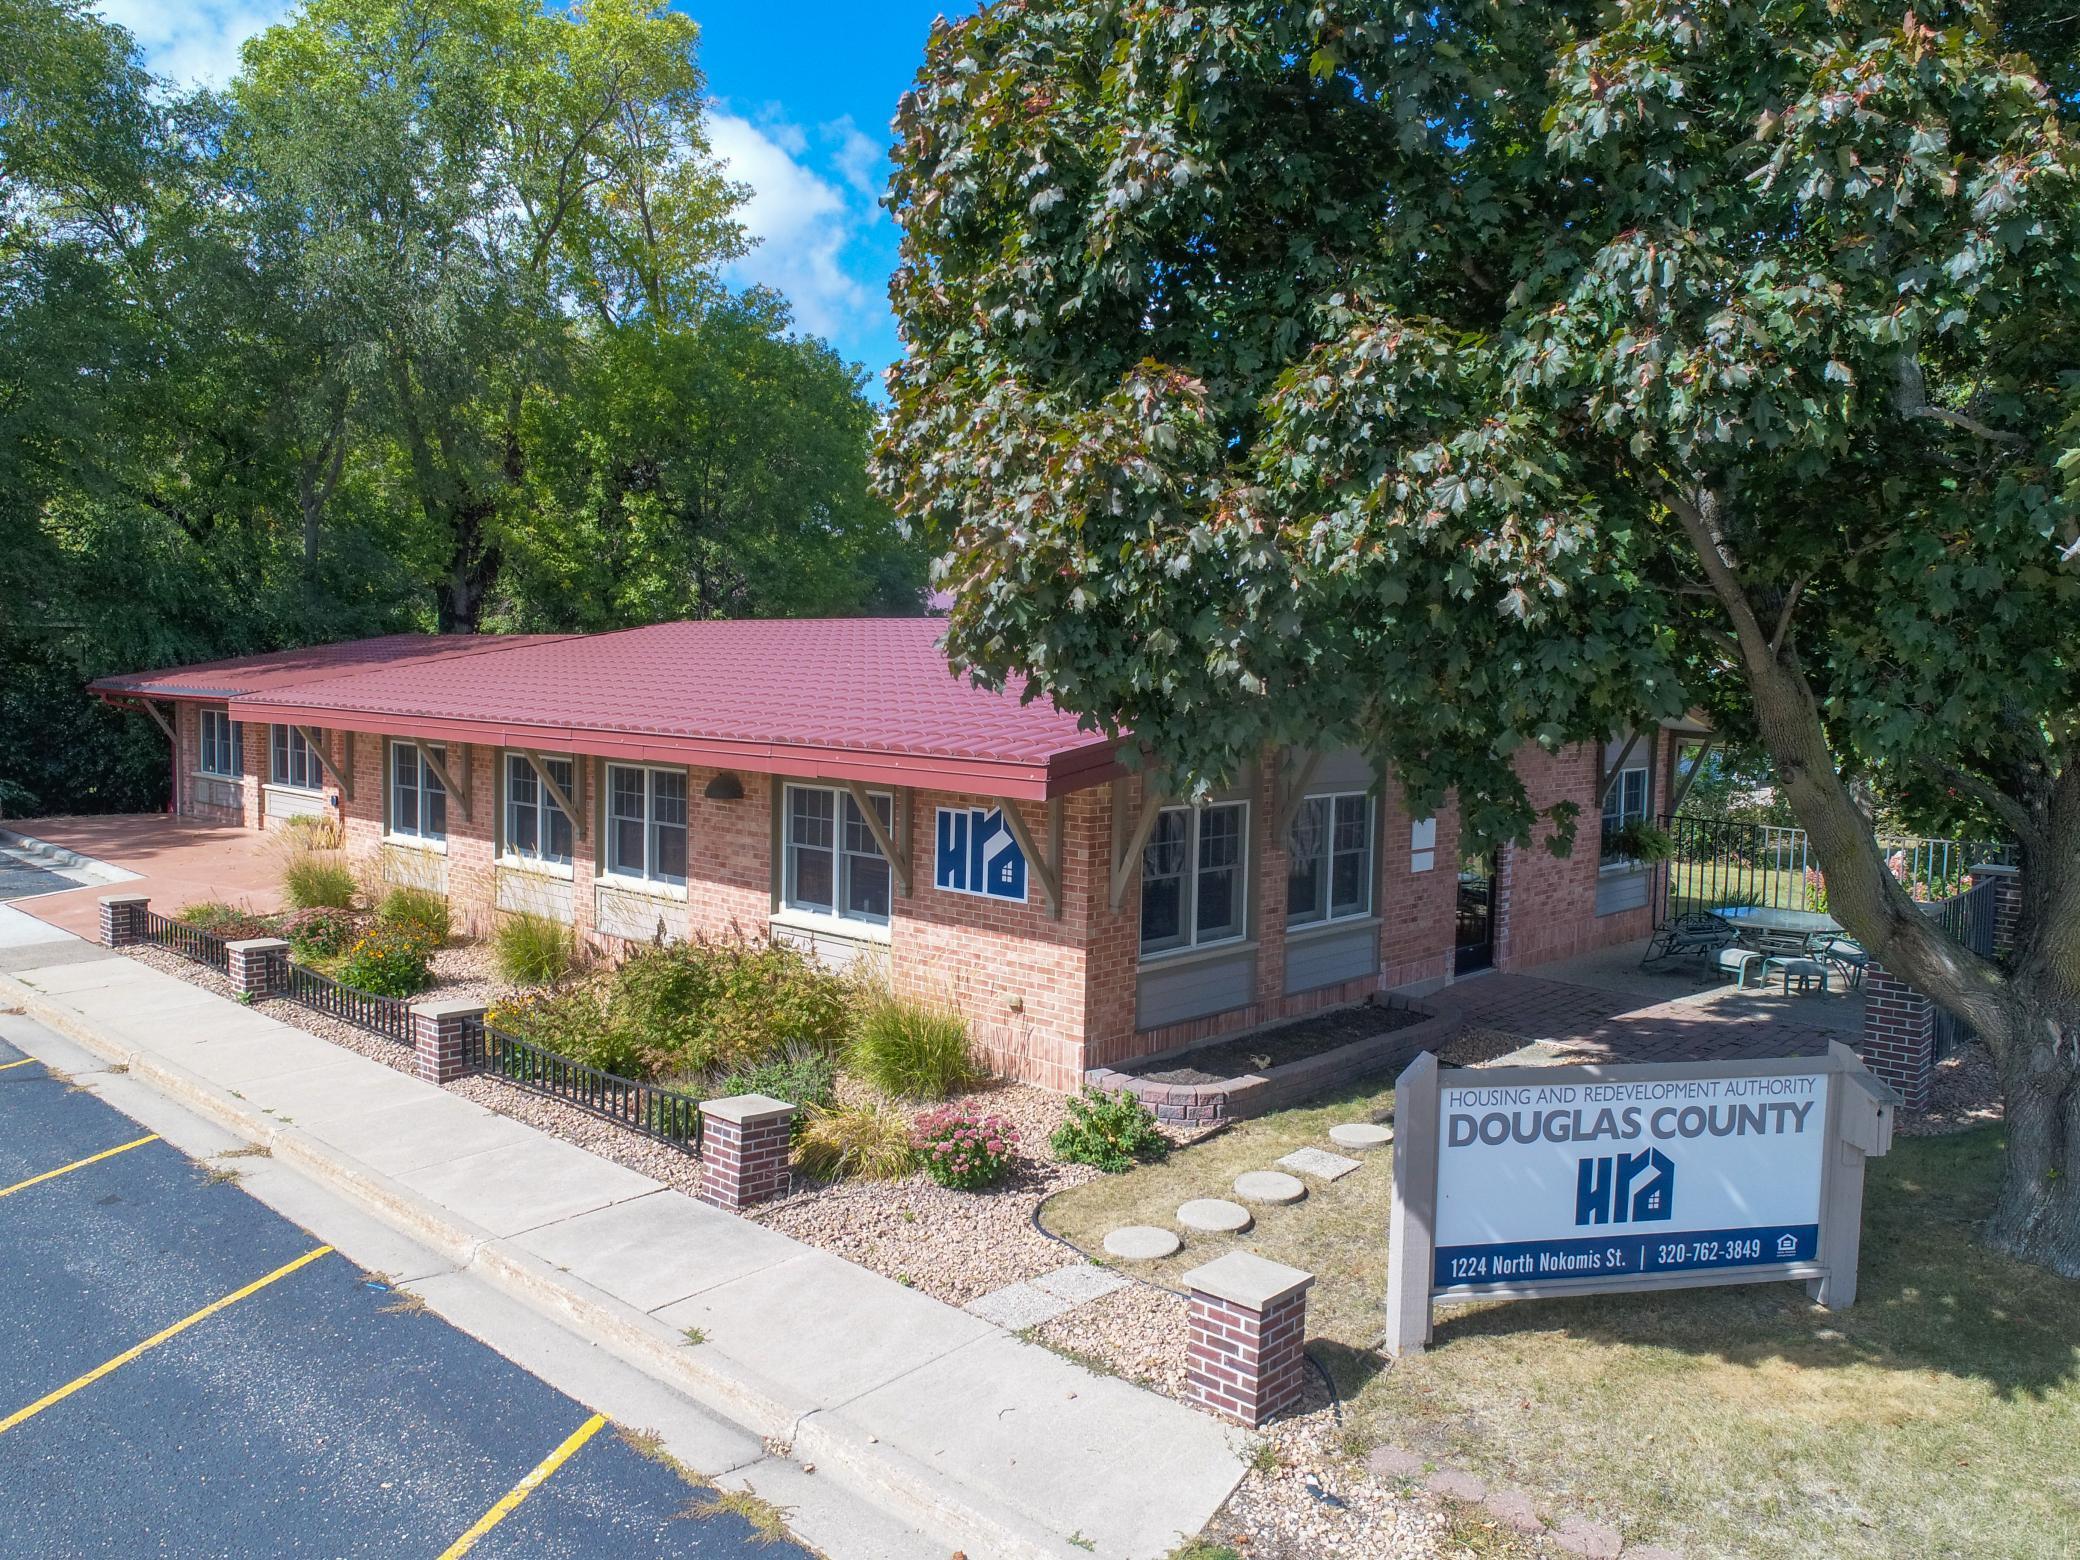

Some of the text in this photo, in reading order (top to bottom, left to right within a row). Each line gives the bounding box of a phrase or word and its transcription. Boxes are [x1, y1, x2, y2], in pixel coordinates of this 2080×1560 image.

[1449, 1077, 1817, 1107] HOUSING AND REDEVELOPMENT AUTHORITY
[1448, 1101, 1815, 1147] DOUGLAS COUNTY
[1451, 1239, 1761, 1278] 1224 North Nokomis St. 320-762-3849
